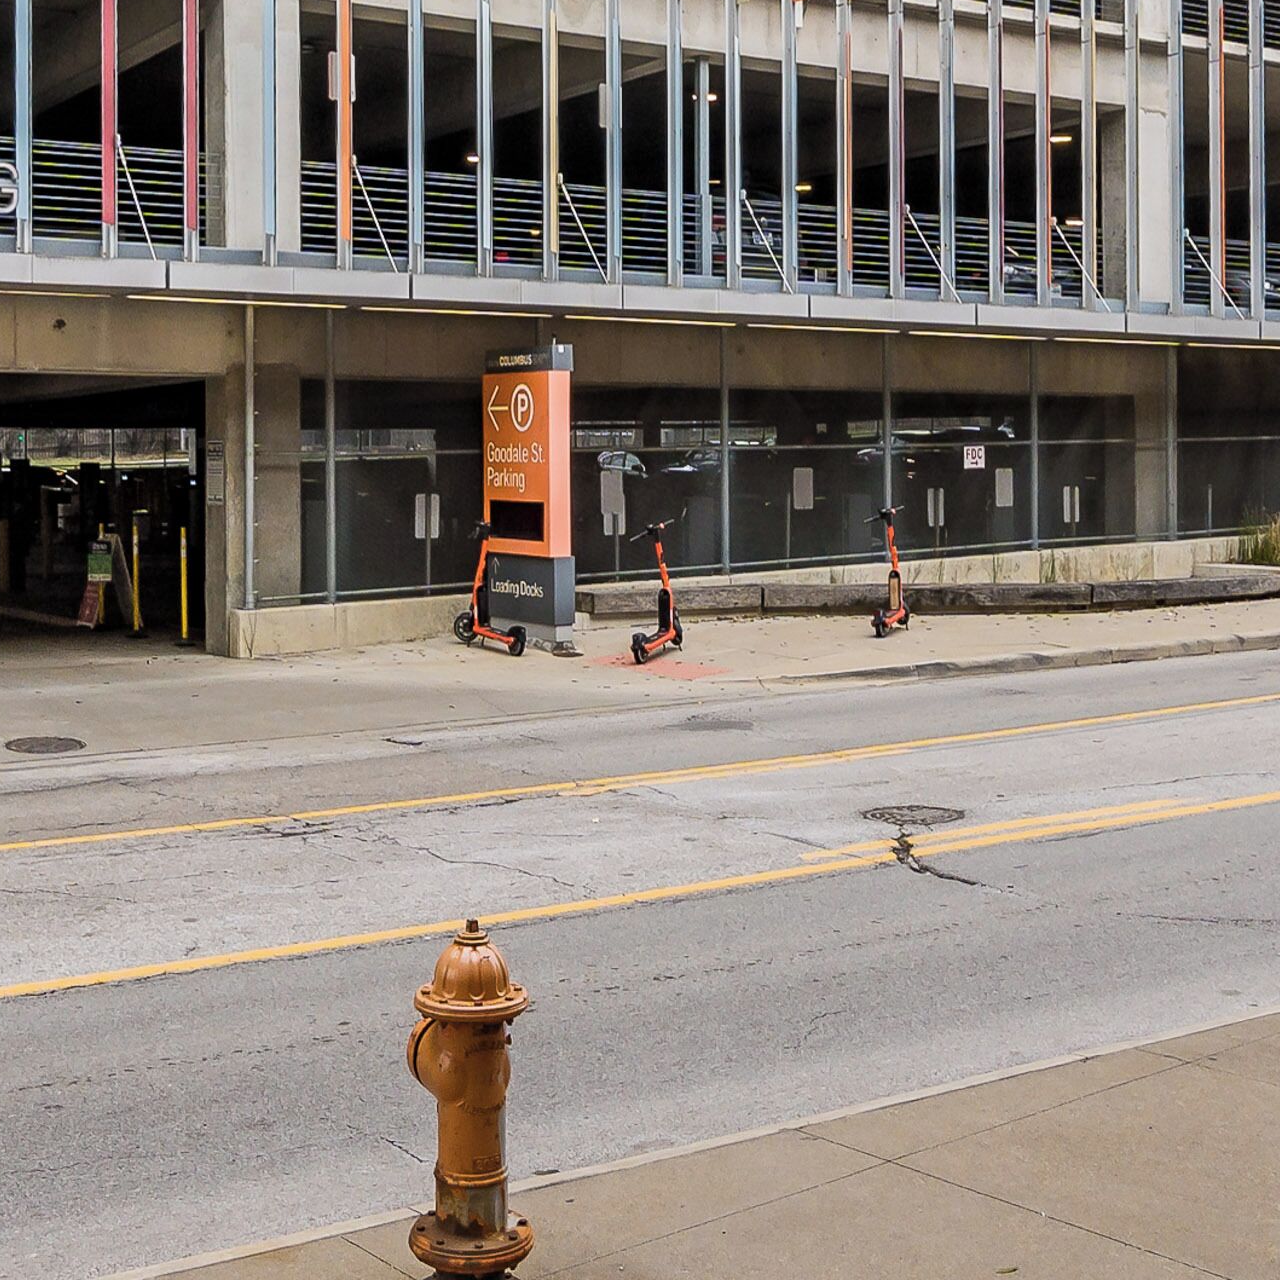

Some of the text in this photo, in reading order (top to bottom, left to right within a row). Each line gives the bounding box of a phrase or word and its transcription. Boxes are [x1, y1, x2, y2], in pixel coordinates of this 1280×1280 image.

[499, 354, 532, 367] COLUMBUS
[487, 441, 546, 464] Goodale St.
[966, 448, 983, 460] FDC
[487, 466, 526, 493] Parking
[490, 577, 544, 598] Loading Docks
